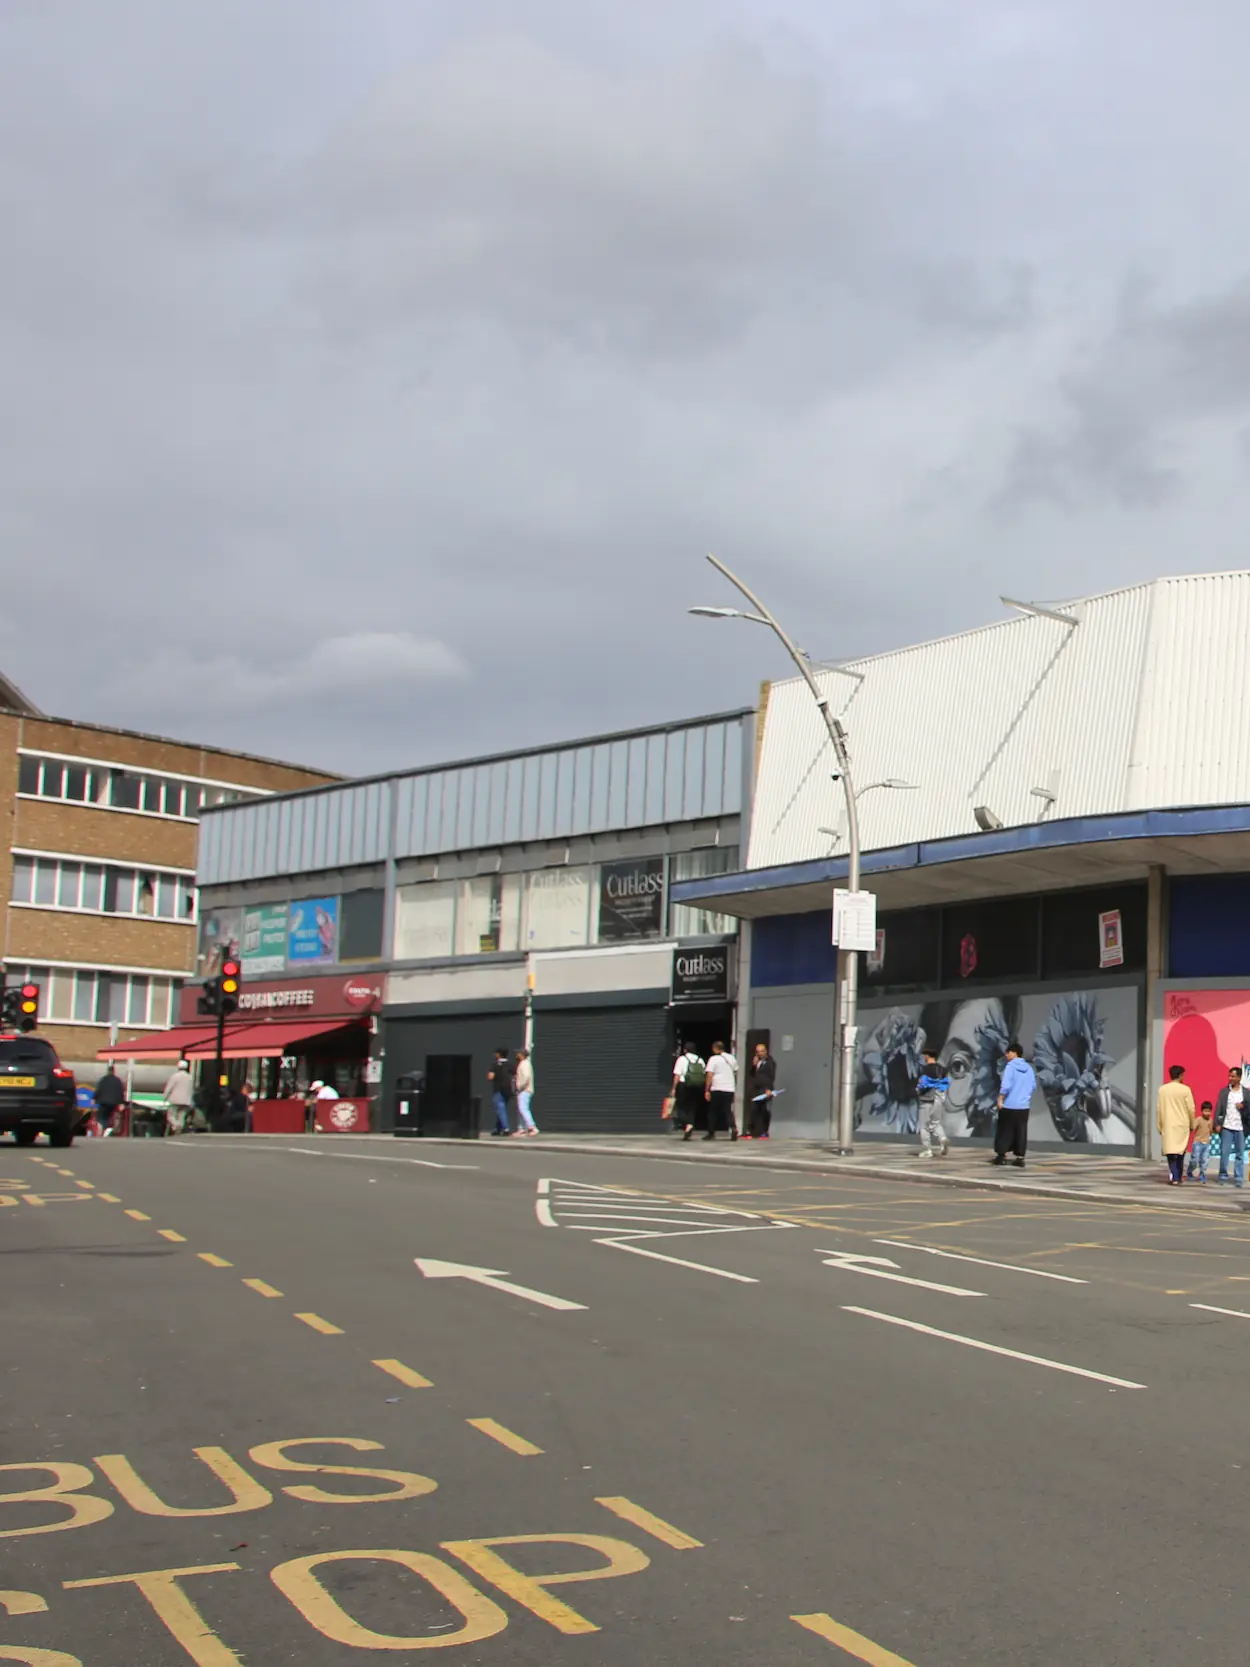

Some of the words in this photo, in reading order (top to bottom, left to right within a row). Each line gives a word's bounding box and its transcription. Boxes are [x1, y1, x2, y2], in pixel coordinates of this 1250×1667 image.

[607, 869, 664, 898] Cutlass
[676, 954, 725, 976] Cutlass
[267, 989, 314, 1007] COFFEE
[0, 1436, 438, 1539] BUS
